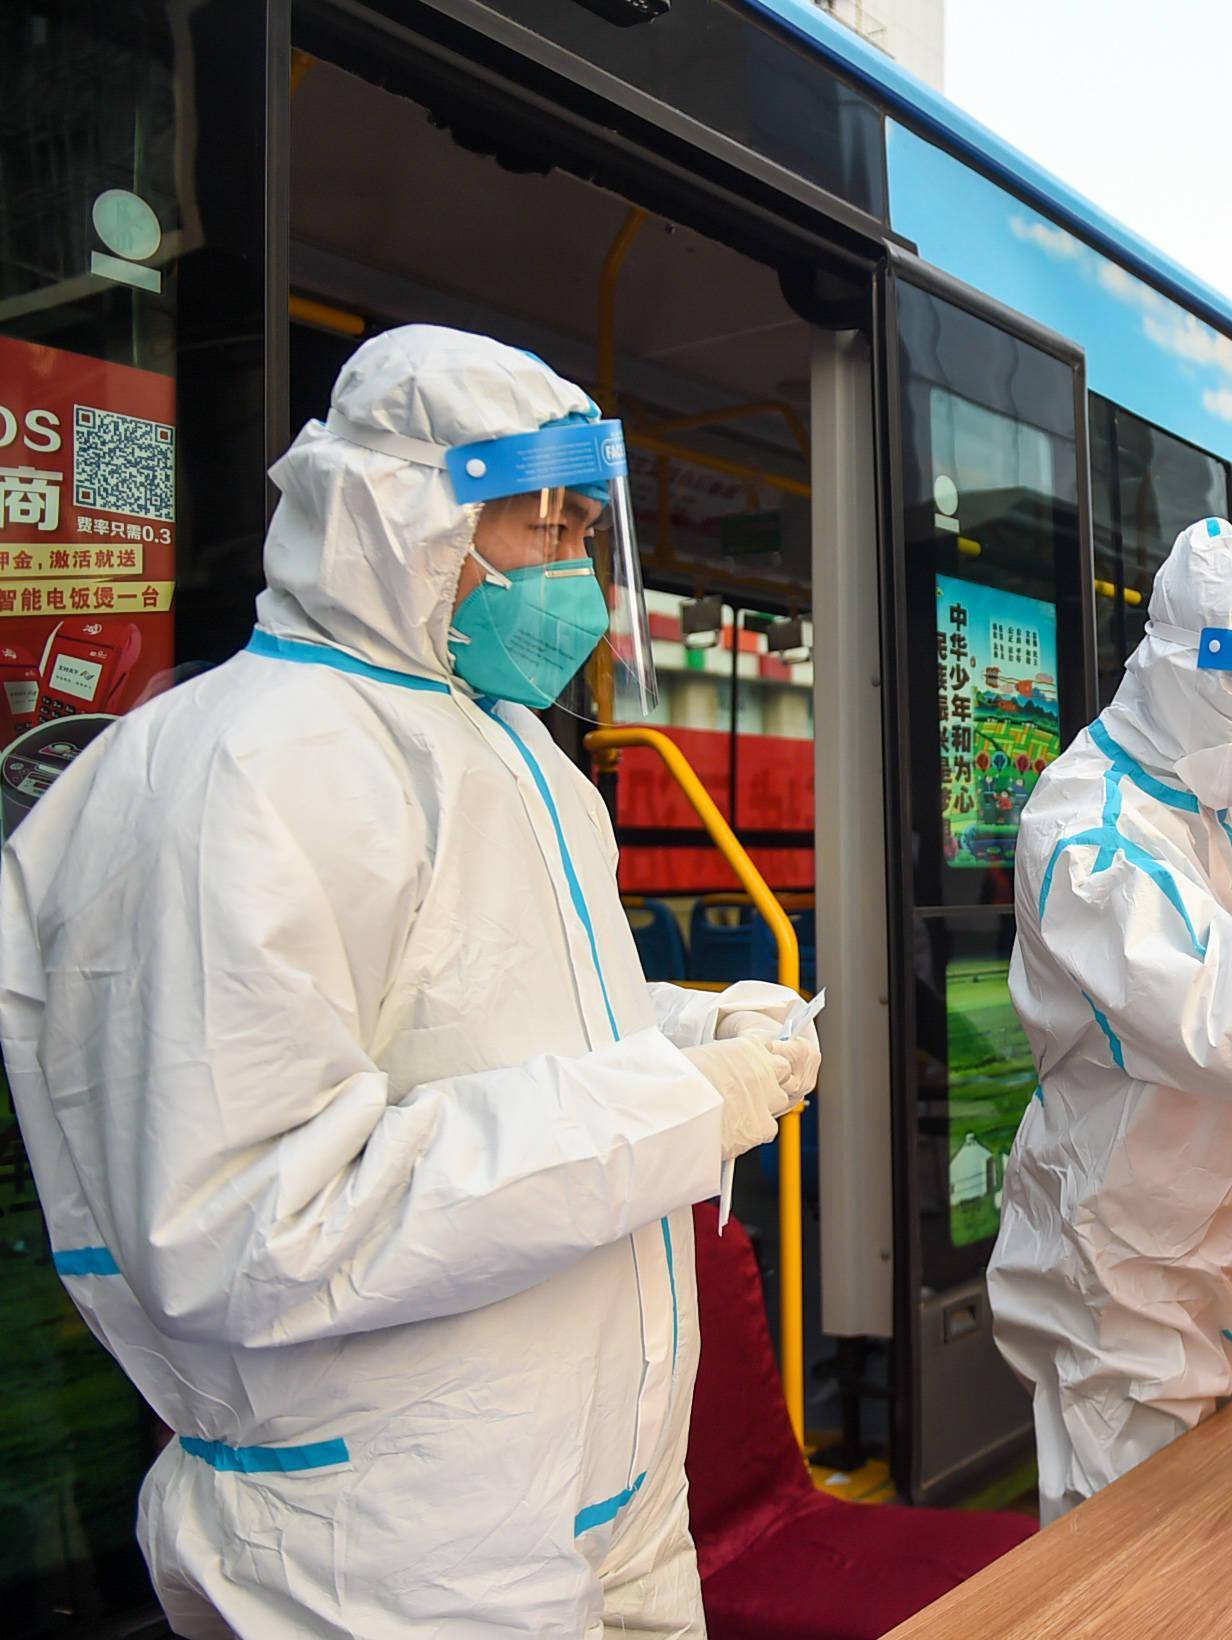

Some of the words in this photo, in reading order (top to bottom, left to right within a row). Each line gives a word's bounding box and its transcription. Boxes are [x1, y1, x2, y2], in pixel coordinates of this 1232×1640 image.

[0, 465, 63, 531] 商
[76, 516, 172, 545] 费率只需0.3
[0, 585, 160, 612] 智能电饭煲一台
[949, 602, 975, 814] 中华少年和为心
